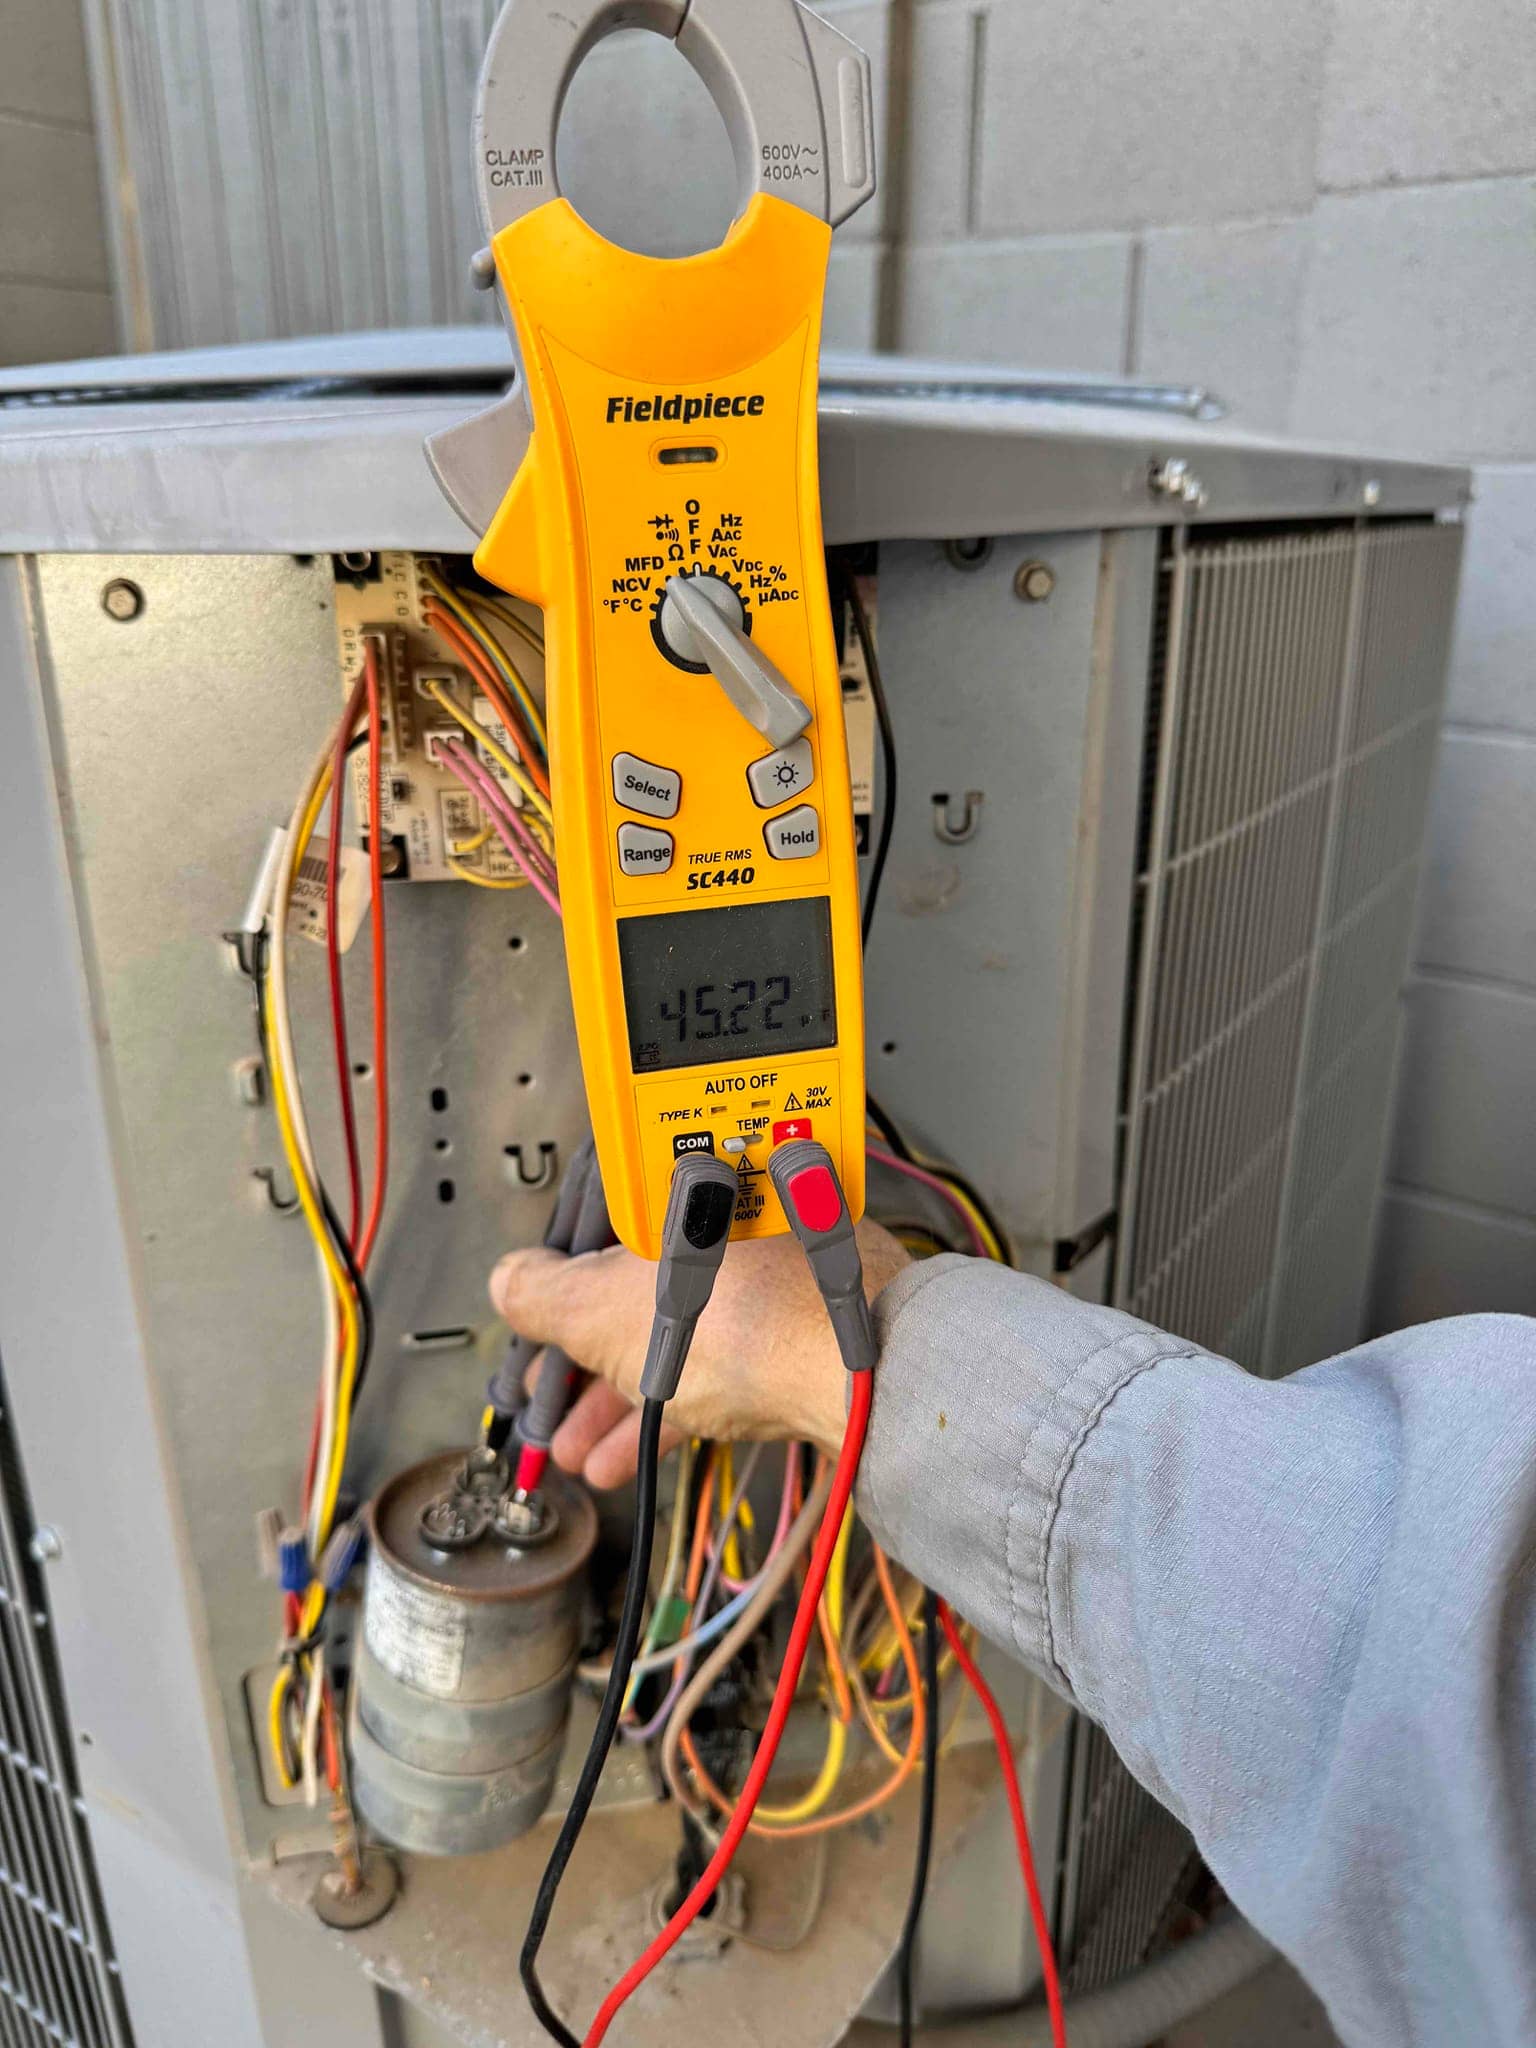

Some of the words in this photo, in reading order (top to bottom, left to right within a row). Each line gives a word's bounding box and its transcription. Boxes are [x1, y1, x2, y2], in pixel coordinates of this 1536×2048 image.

[485, 149, 545, 166] CLAMP
[606, 393, 765, 424] Fieldpiece
[720, 513, 743, 528] Hz
[625, 556, 664, 572] MFD
[612, 577, 651, 593] NCV
[624, 774, 672, 801] Select
[781, 830, 815, 846] Hold
[624, 845, 671, 862] Range
[688, 852, 721, 865] TRUE
[724, 848, 752, 861] RMS
[687, 867, 755, 890] SC440
[704, 1076, 746, 1095] AUTO
[749, 1073, 778, 1089] OFF
[806, 1086, 828, 1098] 30V
[805, 1097, 832, 1110] MAX
[659, 1110, 691, 1122] TYPE
[693, 1107, 703, 1118] K
[736, 1117, 770, 1131] TEMP
[676, 1136, 710, 1150] COM
[736, 1197, 752, 1210] AT
